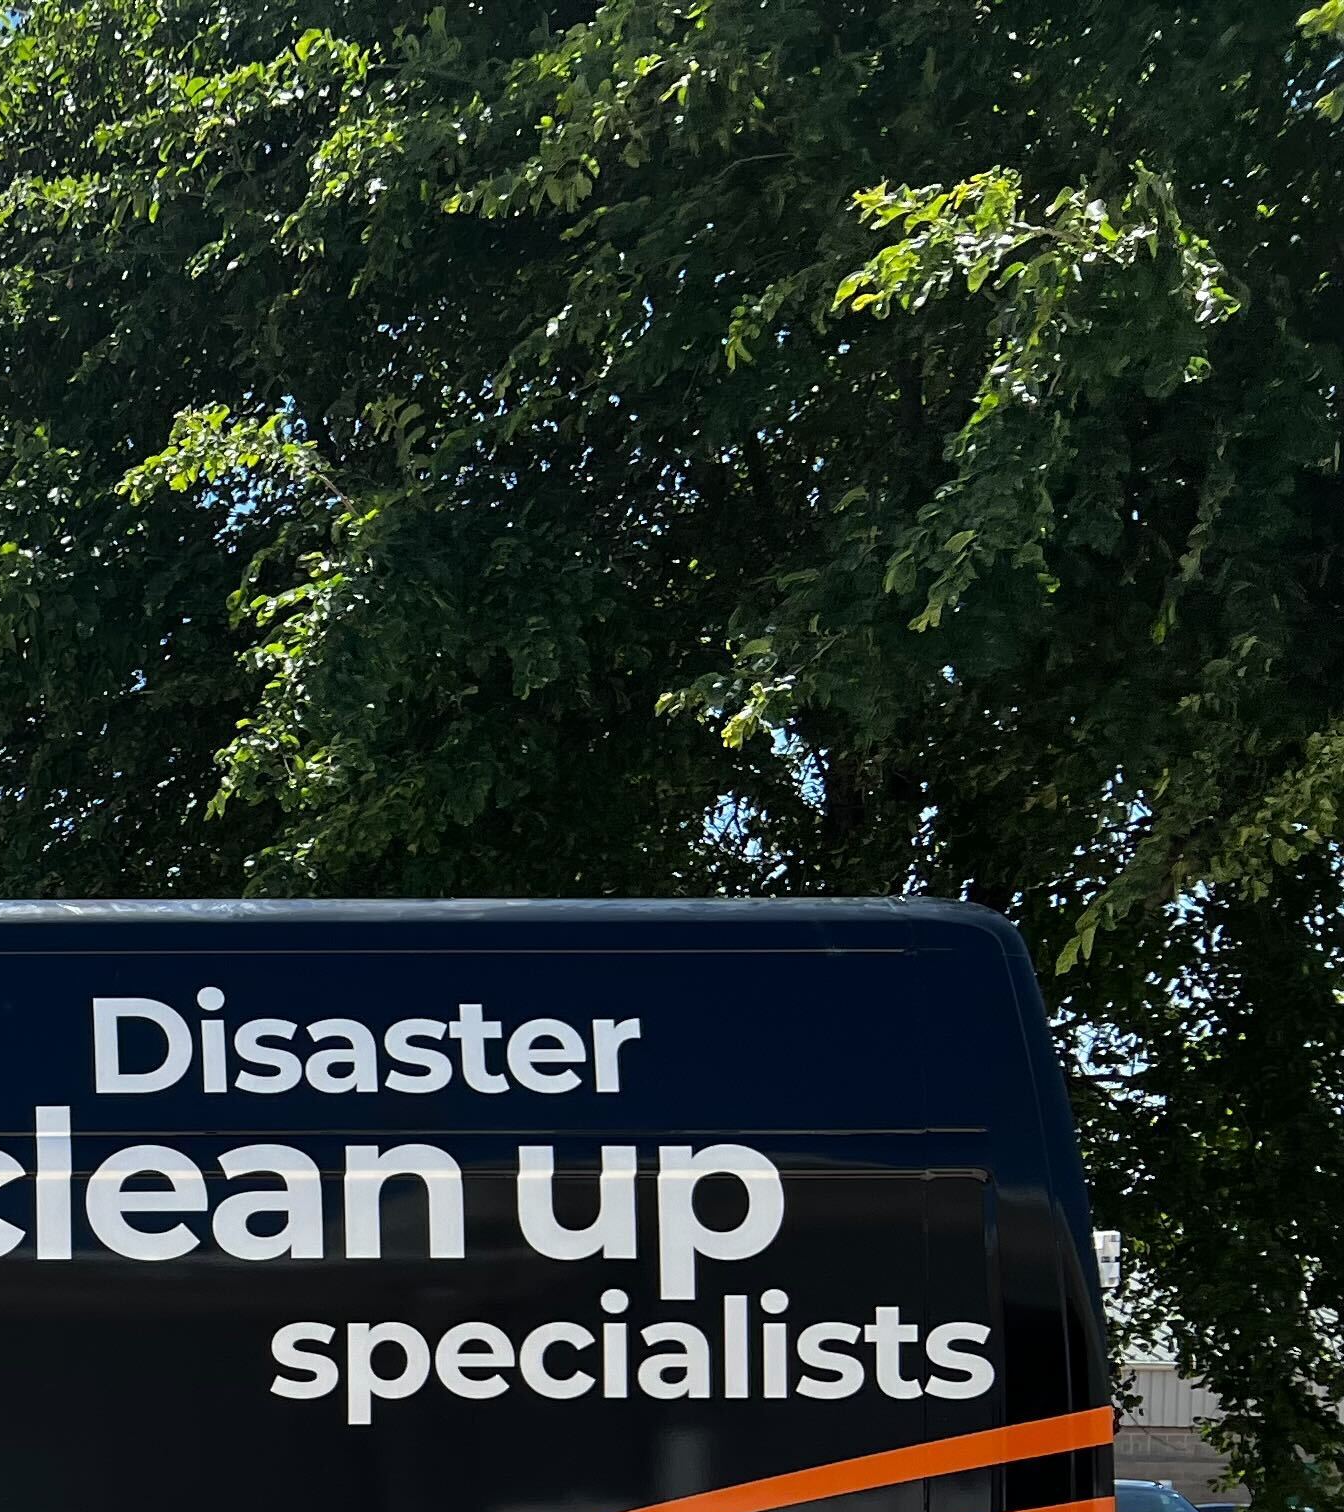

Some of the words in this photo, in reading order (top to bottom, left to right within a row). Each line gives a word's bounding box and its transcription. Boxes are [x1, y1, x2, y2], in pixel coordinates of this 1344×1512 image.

[92, 986, 641, 1094] Disaster
[516, 1143, 789, 1301] up
[269, 1288, 995, 1425] specialists
